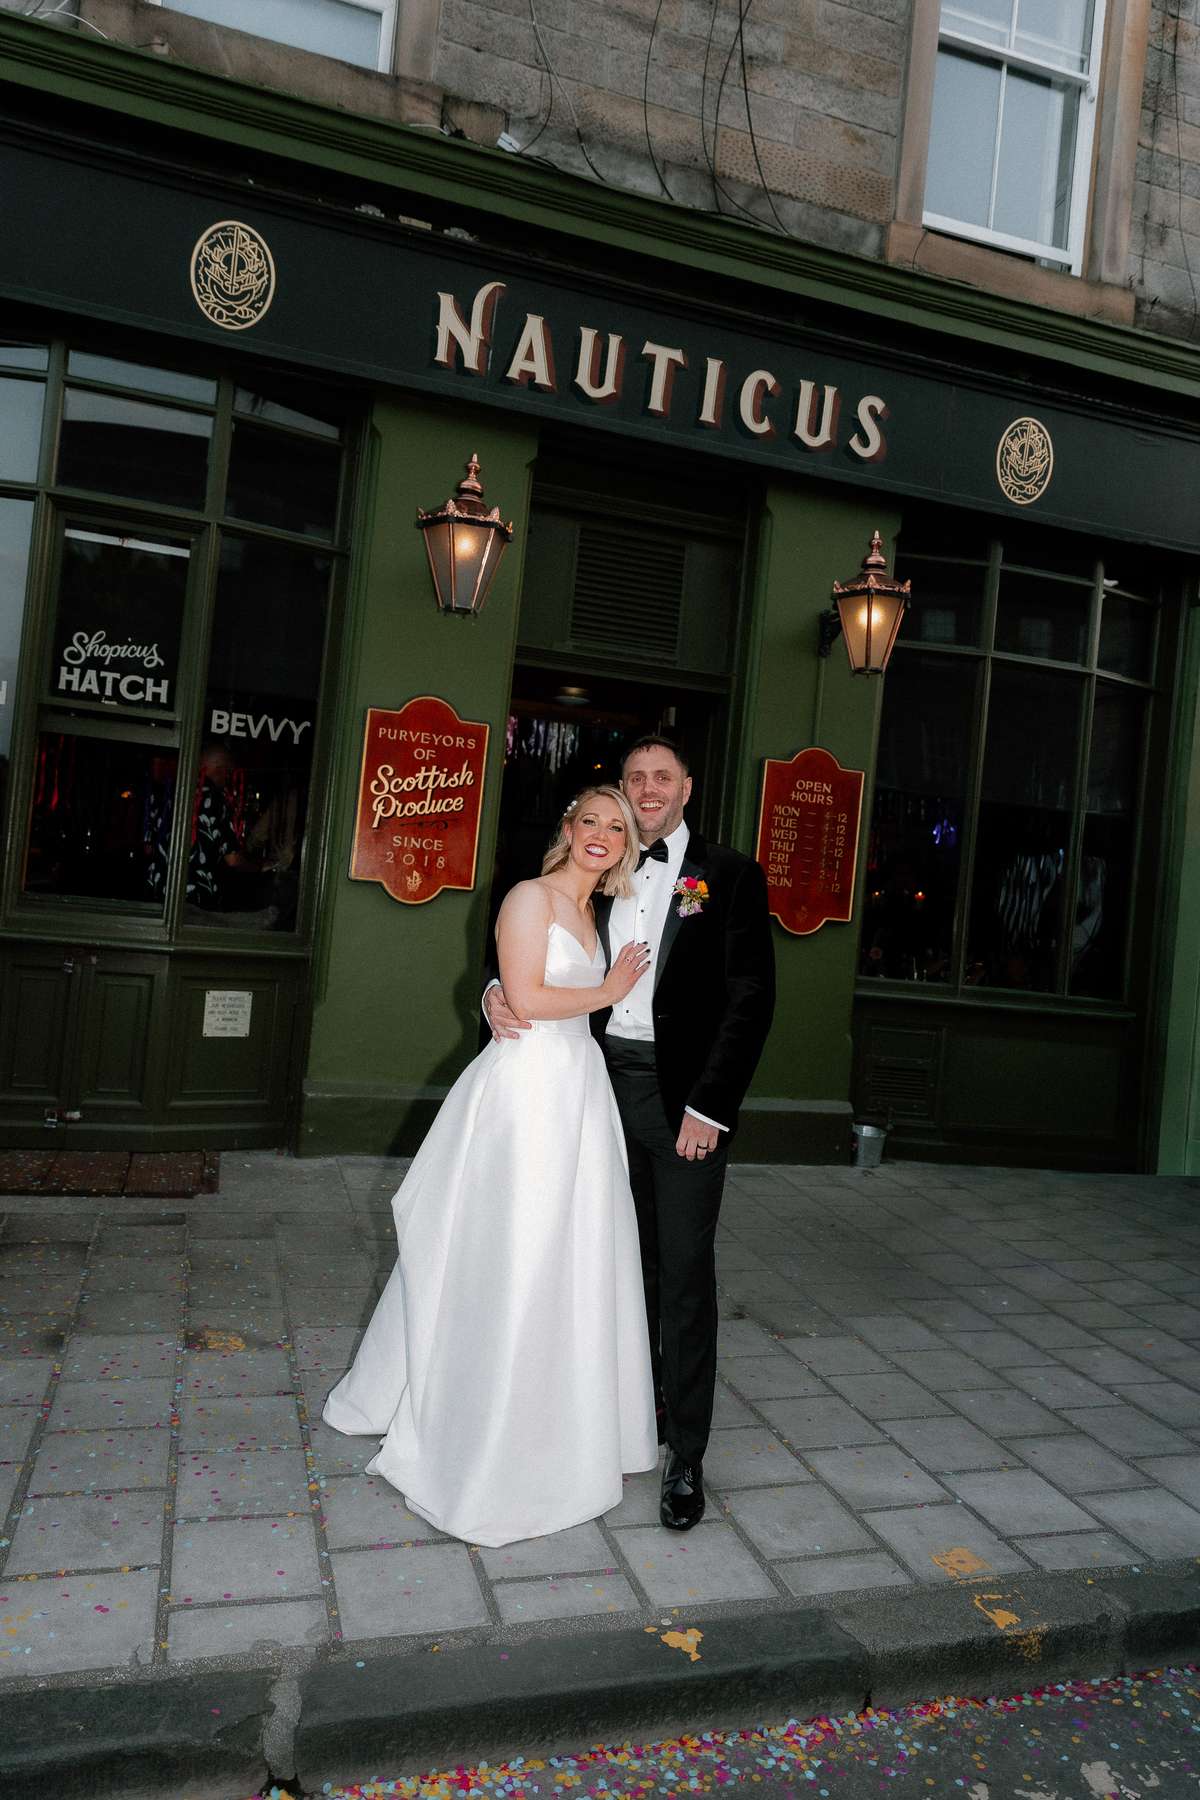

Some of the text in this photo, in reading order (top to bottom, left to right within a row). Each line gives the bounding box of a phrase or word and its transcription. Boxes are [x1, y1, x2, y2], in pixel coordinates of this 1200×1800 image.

[433, 281, 889, 461] NAUTICUS
[63, 630, 165, 668] Shopicus
[58, 666, 169, 704] HATCH
[210, 709, 311, 745] BEVVY
[378, 727, 477, 750] PURVEYORS
[413, 748, 437, 761] OF
[370, 759, 474, 796] Scottish
[796, 780, 832, 793] OPEN
[790, 791, 834, 806] HOURS
[372, 789, 464, 829] Produce
[772, 805, 800, 817] MON
[772, 817, 798, 829] TUE
[771, 828, 798, 841] WED
[392, 836, 444, 851] SINCE
[770, 840, 795, 853] THU
[768, 852, 789, 864] FRI
[768, 863, 791, 875] SAT
[767, 876, 792, 888] SUN
